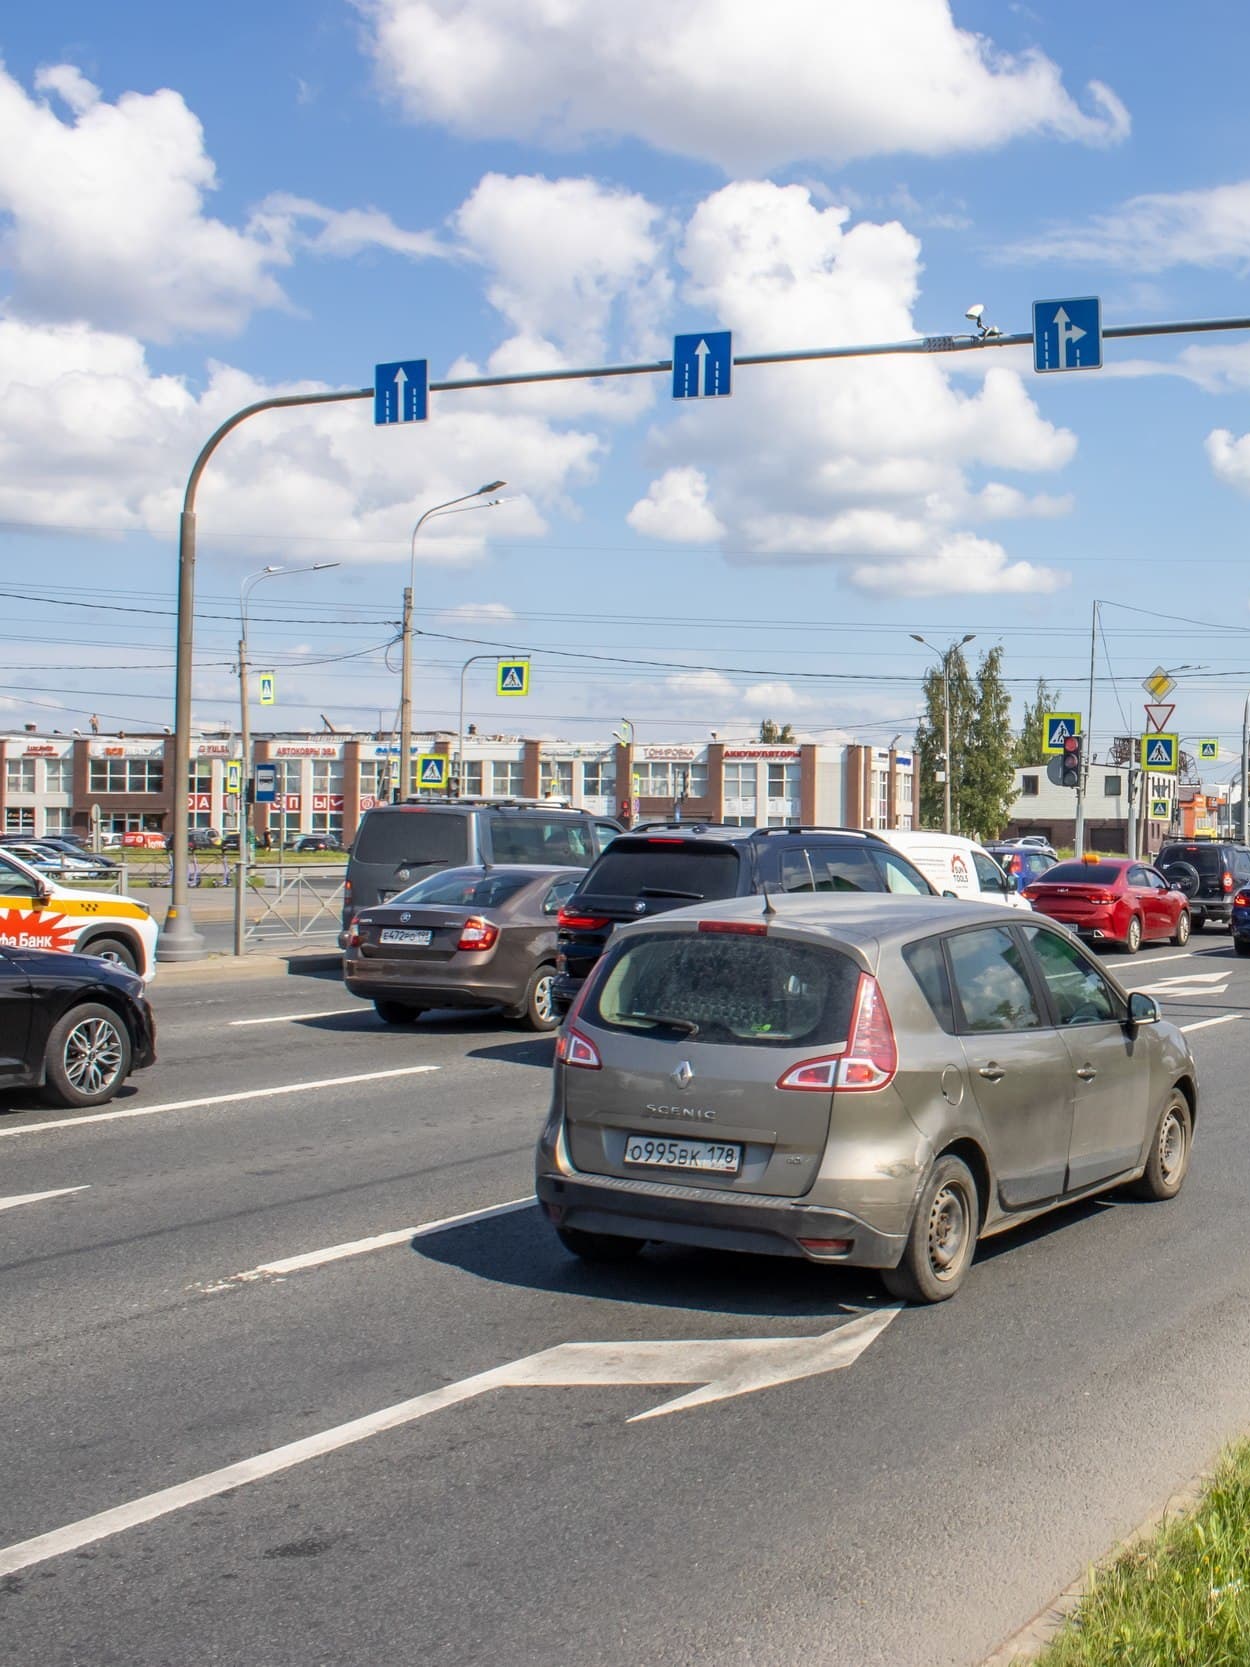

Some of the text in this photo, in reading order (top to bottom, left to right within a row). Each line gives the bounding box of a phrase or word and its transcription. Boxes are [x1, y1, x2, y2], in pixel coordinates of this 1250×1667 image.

[643, 748, 695, 757] ТОНИРОВКА
[723, 750, 801, 758] АККУМУЛЯТОРЫ
[19, 932, 53, 947] Банк
[646, 1103, 716, 1120] SCENIC
[707, 1145, 736, 1164] 178
